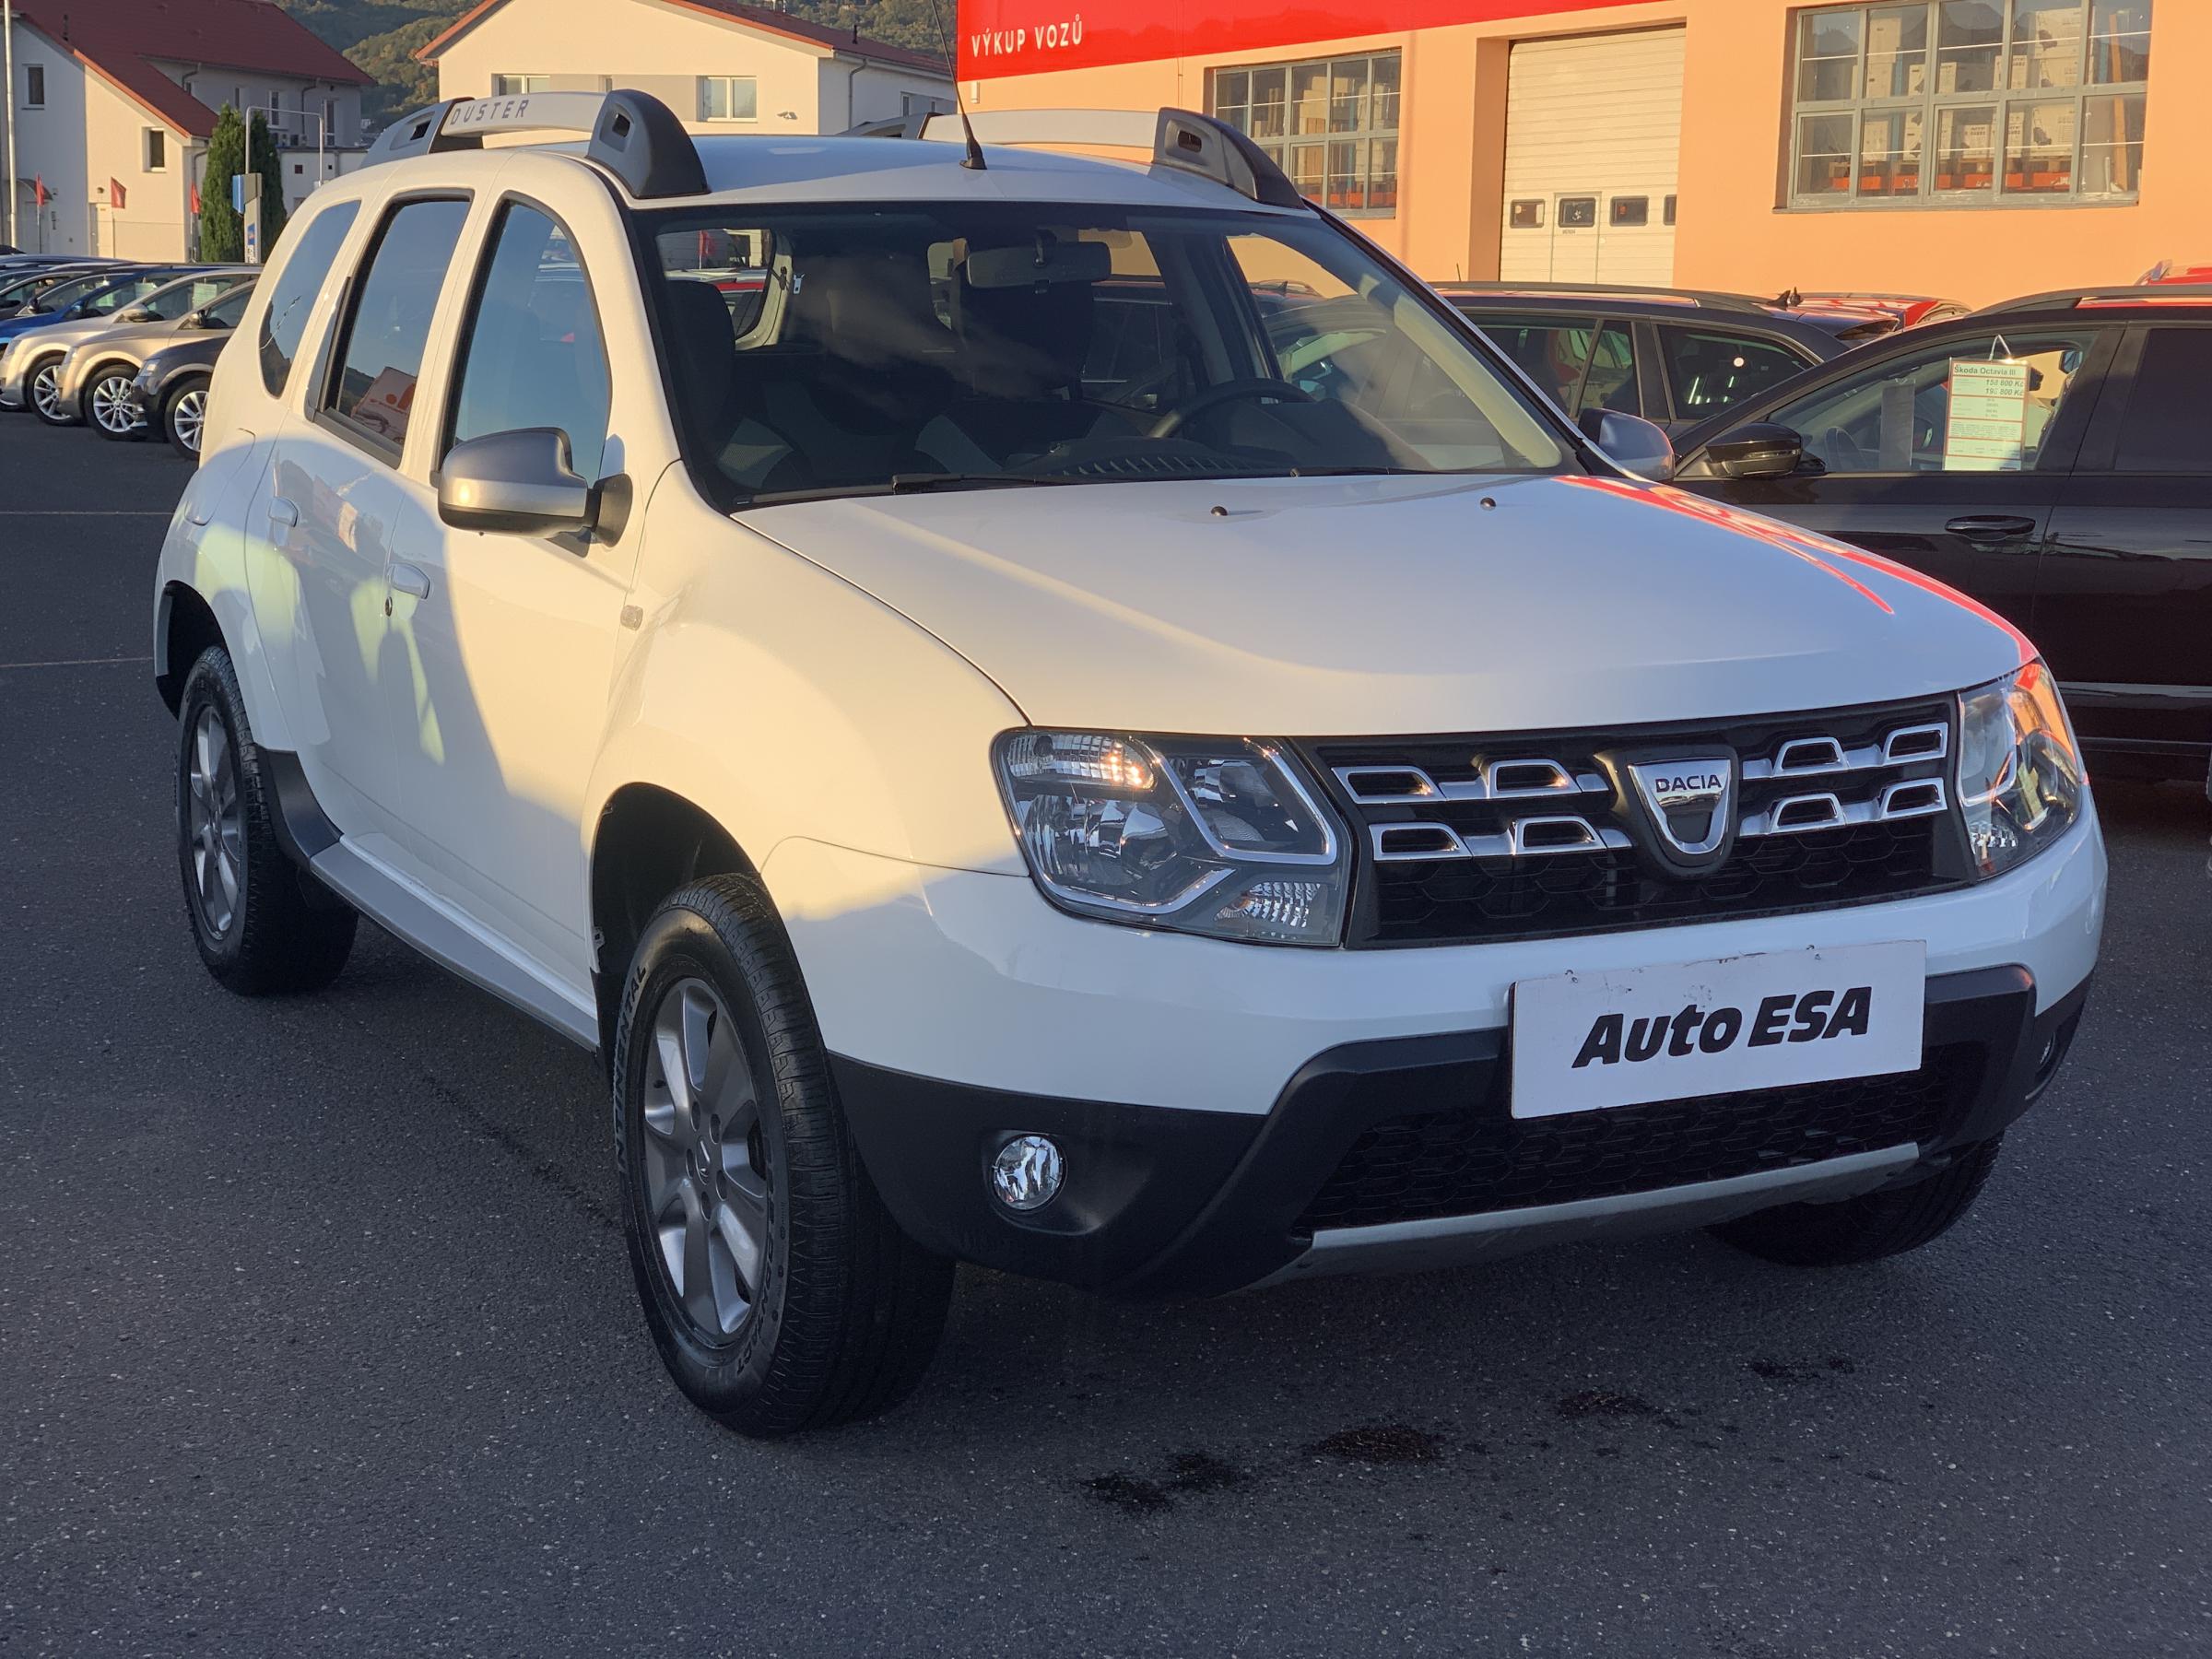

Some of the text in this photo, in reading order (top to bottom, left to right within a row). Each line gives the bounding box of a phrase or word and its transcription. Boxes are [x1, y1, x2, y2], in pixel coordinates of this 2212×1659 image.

[971, 13, 1083, 58] VÝKUP VOZŮ
[450, 99, 530, 125] DUSTER
[1954, 364, 1978, 373] Škoda
[1980, 367, 2008, 375] Octavia
[1654, 774, 1722, 793] DACIA
[1571, 986, 1872, 1069] Auto ESA
[613, 964, 647, 1173] NTINENTAL
